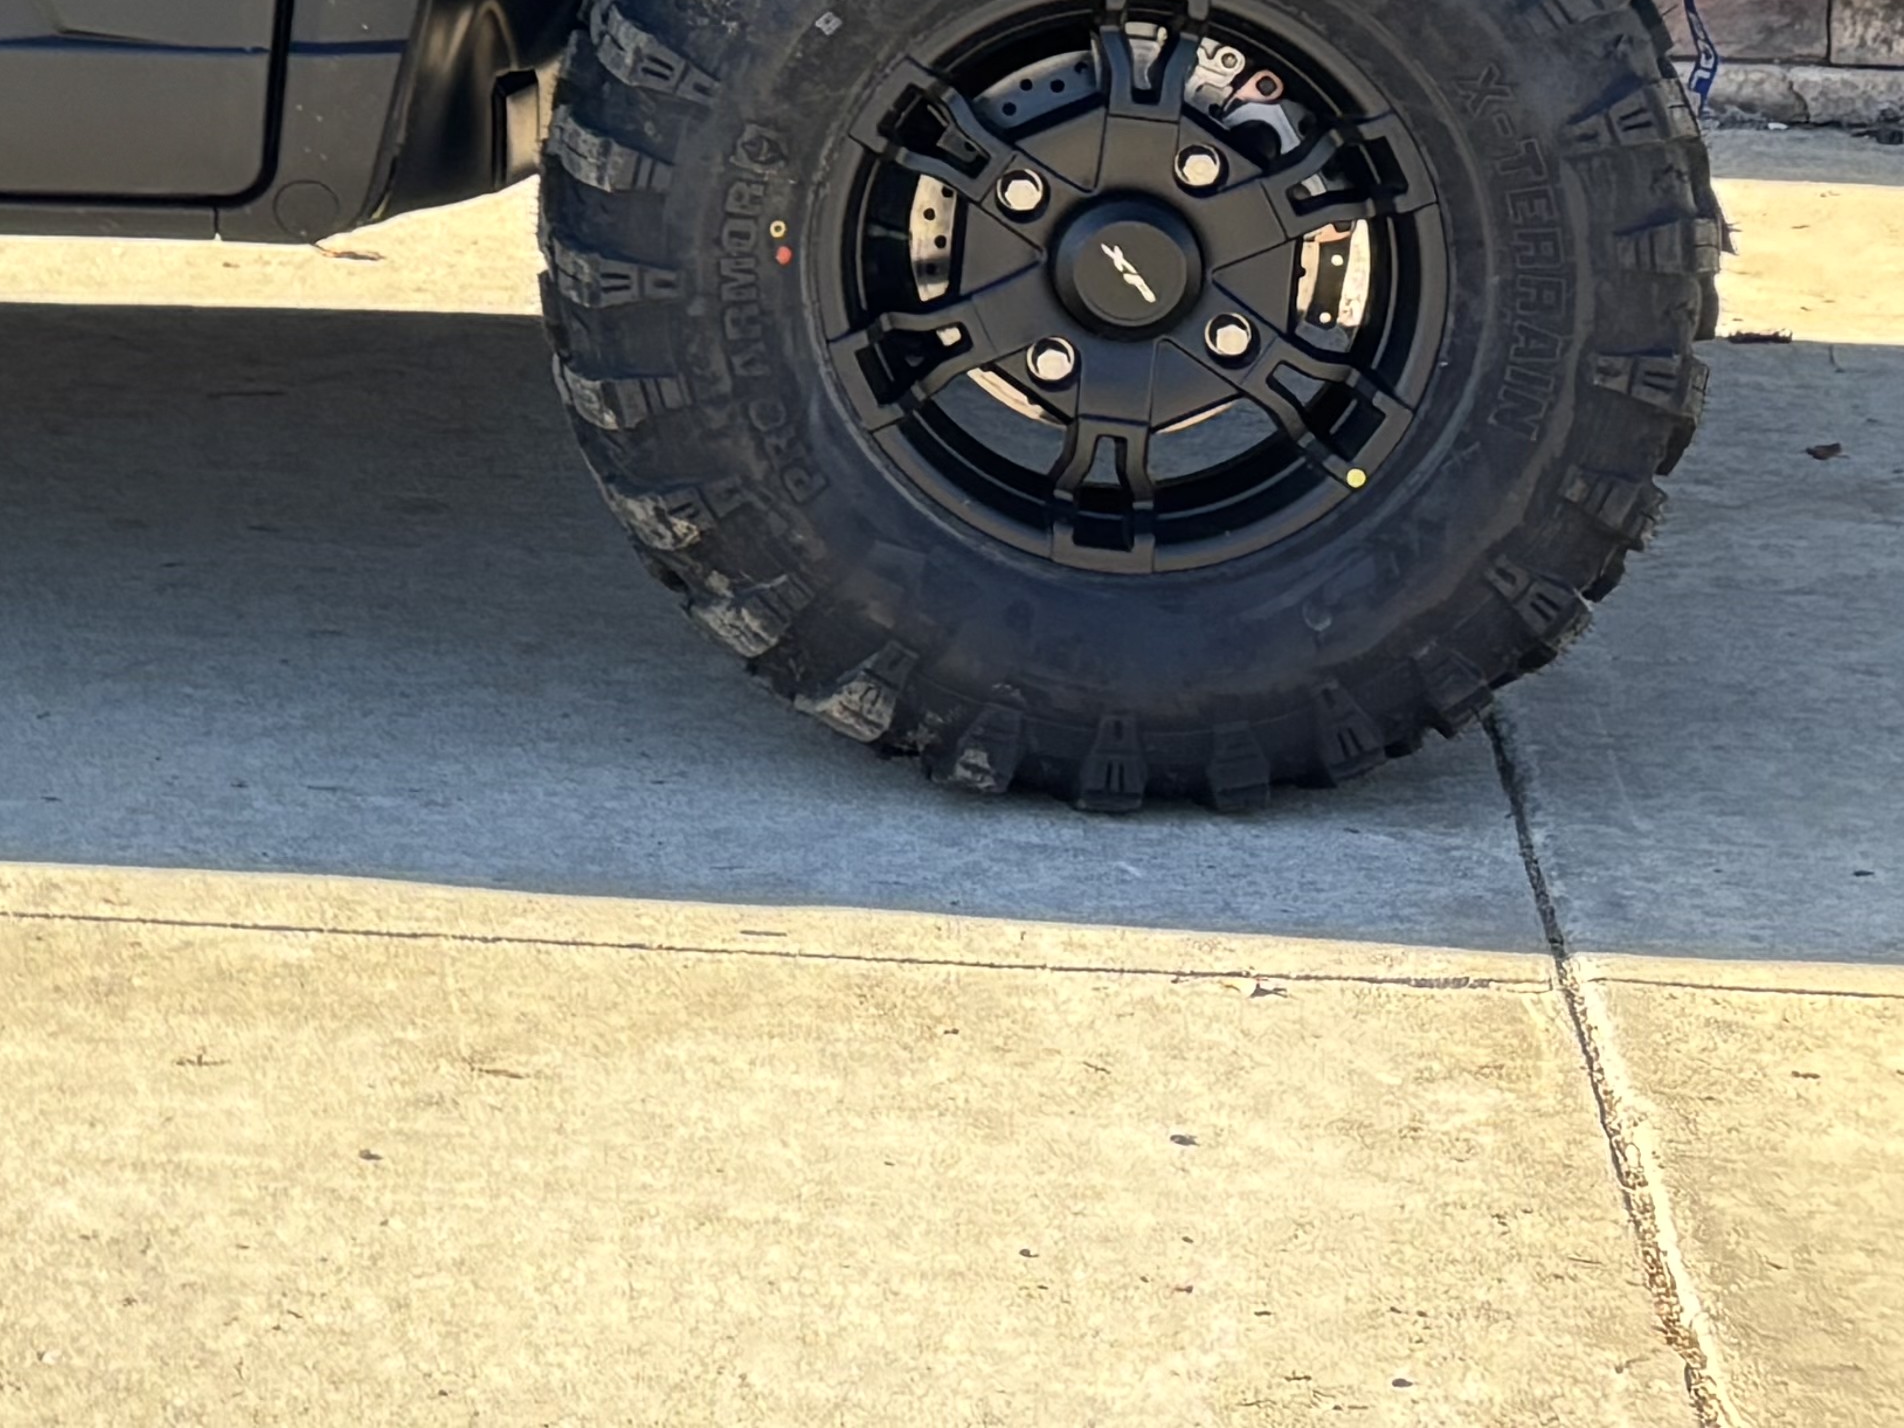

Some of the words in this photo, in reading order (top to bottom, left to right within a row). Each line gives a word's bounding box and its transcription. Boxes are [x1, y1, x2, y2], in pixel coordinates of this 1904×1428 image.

[720, 178, 772, 382] ARMOR
[1099, 241, 1158, 305] XP
[1454, 59, 1571, 442] X-TERRAIN
